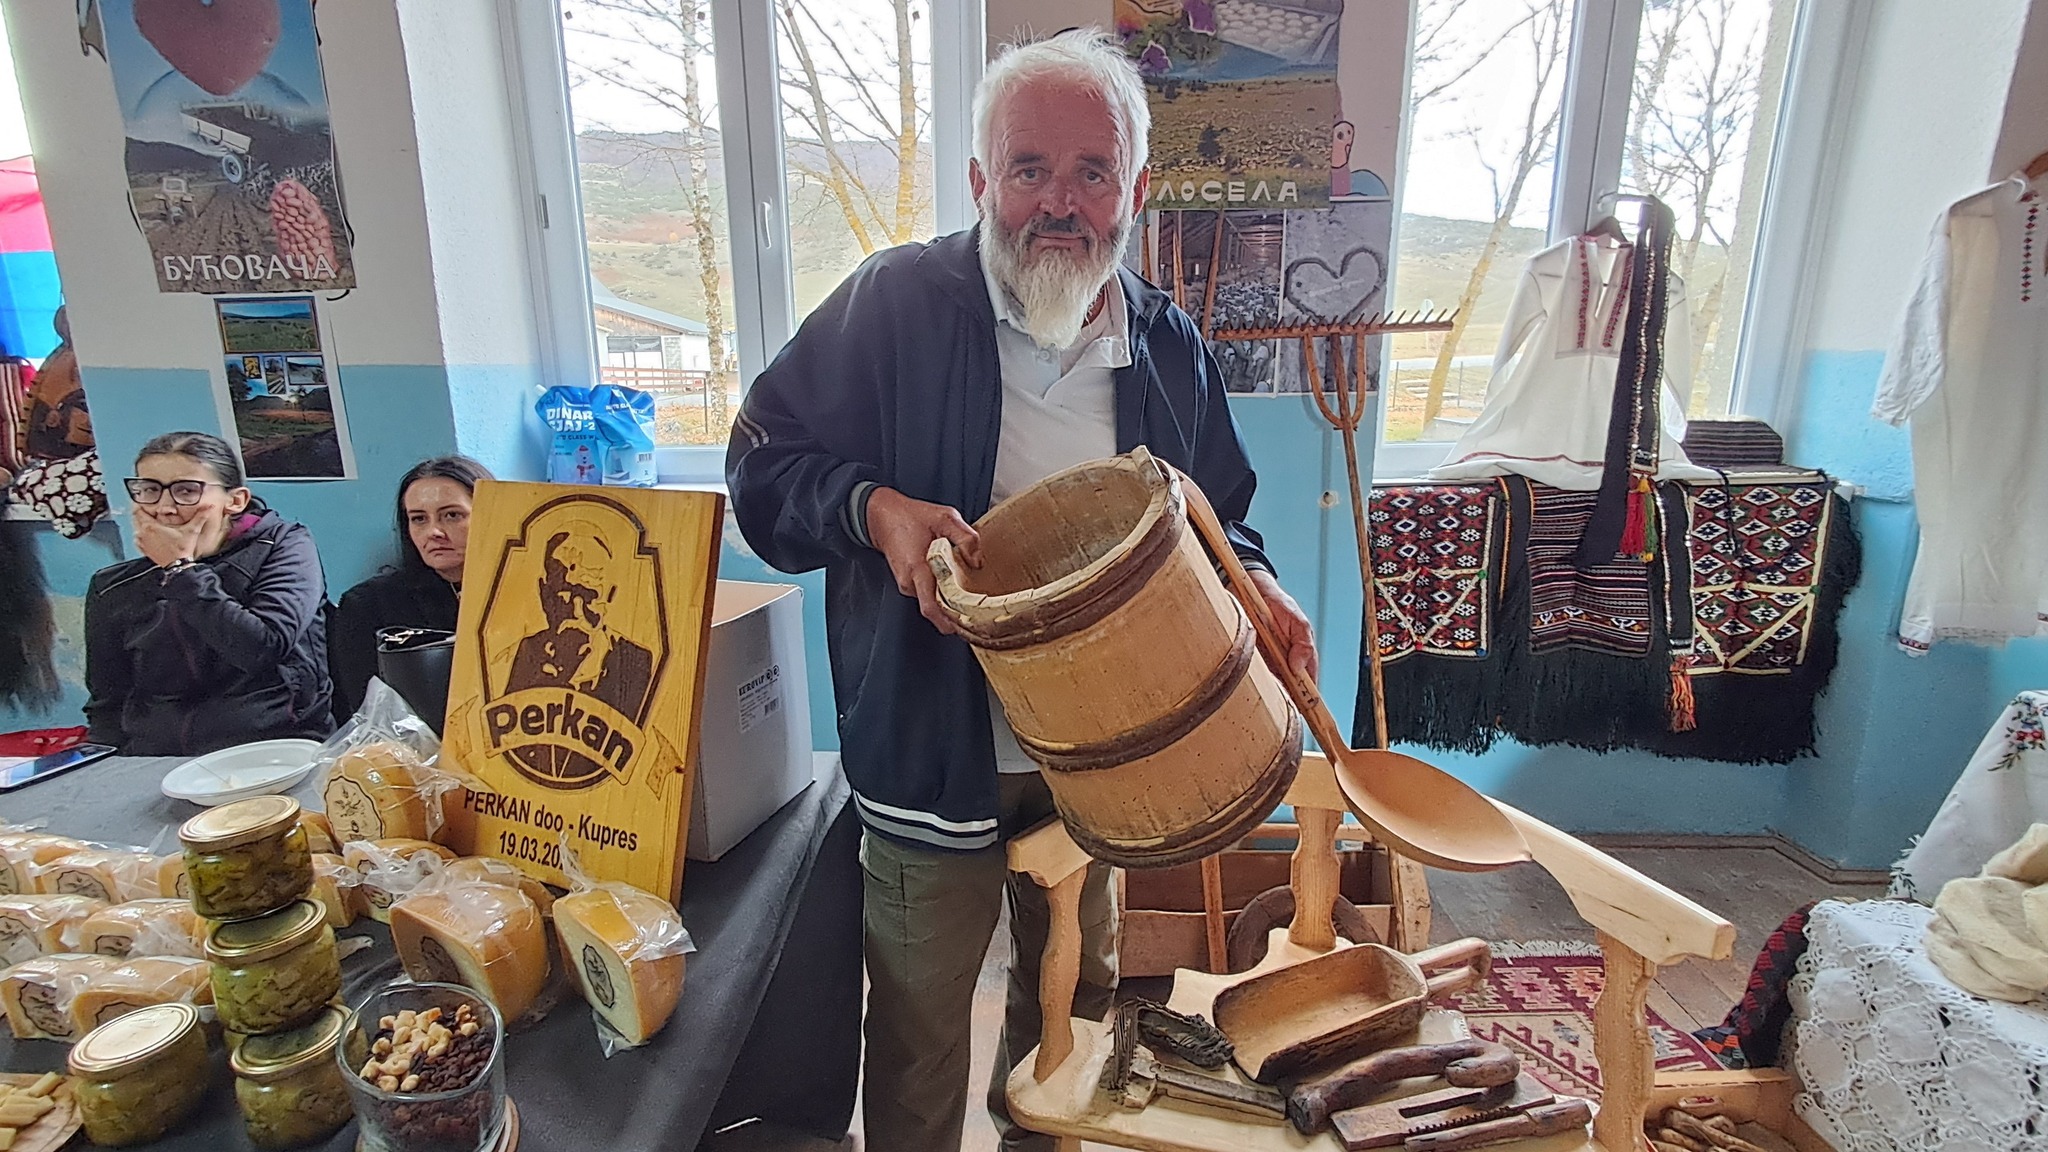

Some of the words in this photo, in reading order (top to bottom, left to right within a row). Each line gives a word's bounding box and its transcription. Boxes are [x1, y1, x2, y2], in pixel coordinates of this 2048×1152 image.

[1146, 180, 1298, 202] ЛОСЕЛА
[162, 254, 337, 281] БУЋОВАЧА
[486, 693, 634, 772] perkan
[464, 789, 531, 824] PERKAN
[534, 804, 563, 832] doo
[578, 814, 638, 851] Kupres
[499, 830, 579, 872] 19.03.20
